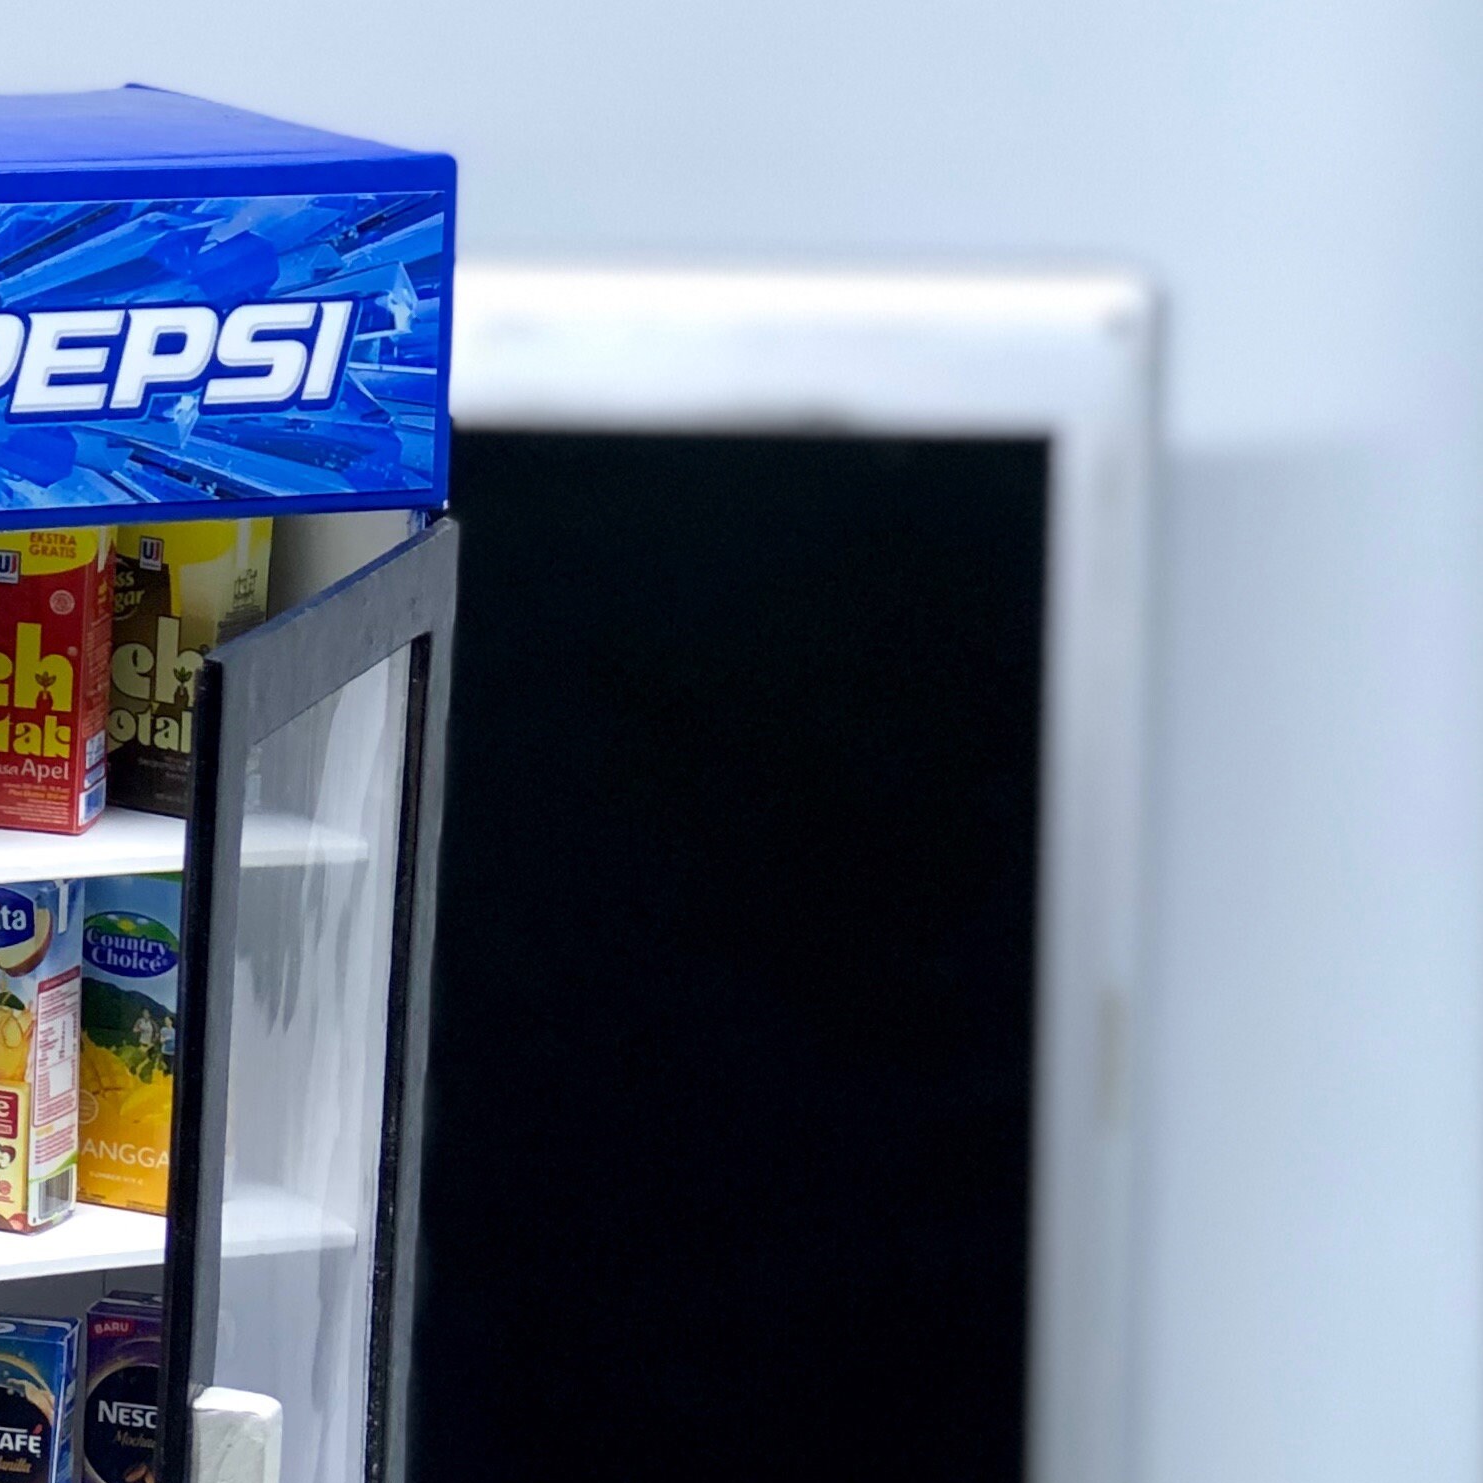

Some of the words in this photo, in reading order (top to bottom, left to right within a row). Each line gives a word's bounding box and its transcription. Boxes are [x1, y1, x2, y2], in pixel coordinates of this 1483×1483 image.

[29, 532, 77, 546] EKSTRA
[29, 545, 77, 559] GRATIS
[110, 614, 205, 707] eh
[21, 758, 69, 783] Apel
[86, 926, 168, 958] Country
[91, 945, 163, 973] Choice
[80, 1137, 170, 1169] ANGGA
[95, 1321, 130, 1334] BARU
[98, 1400, 157, 1429] NESC
